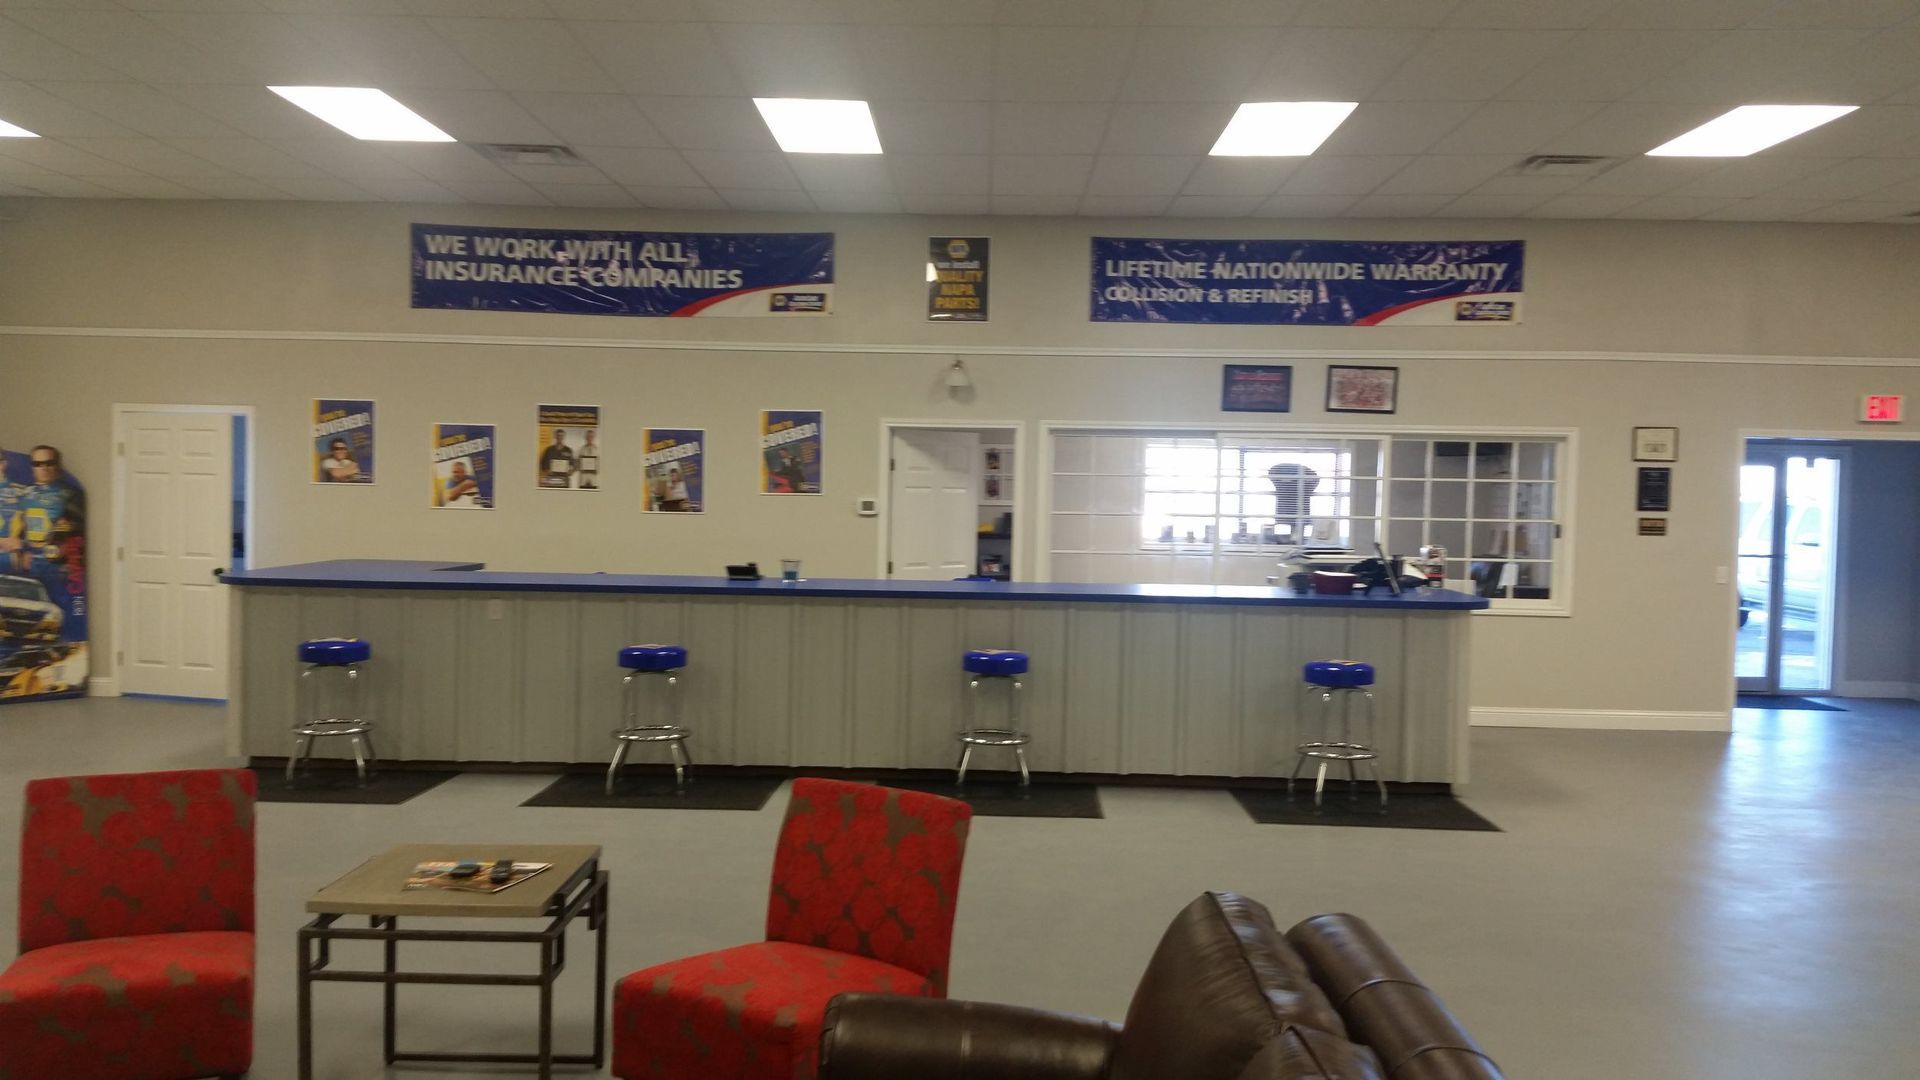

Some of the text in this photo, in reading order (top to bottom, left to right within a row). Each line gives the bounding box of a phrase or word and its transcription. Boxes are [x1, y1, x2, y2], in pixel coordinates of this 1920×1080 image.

[425, 234, 688, 263] WE WORK WITH ALL
[425, 260, 743, 289] INSURANCE COMPANIES
[1105, 259, 1509, 281] LIFETIME NATIONWIDE WARRANTY
[1104, 286, 1313, 304] COLLISION & REFINISH
